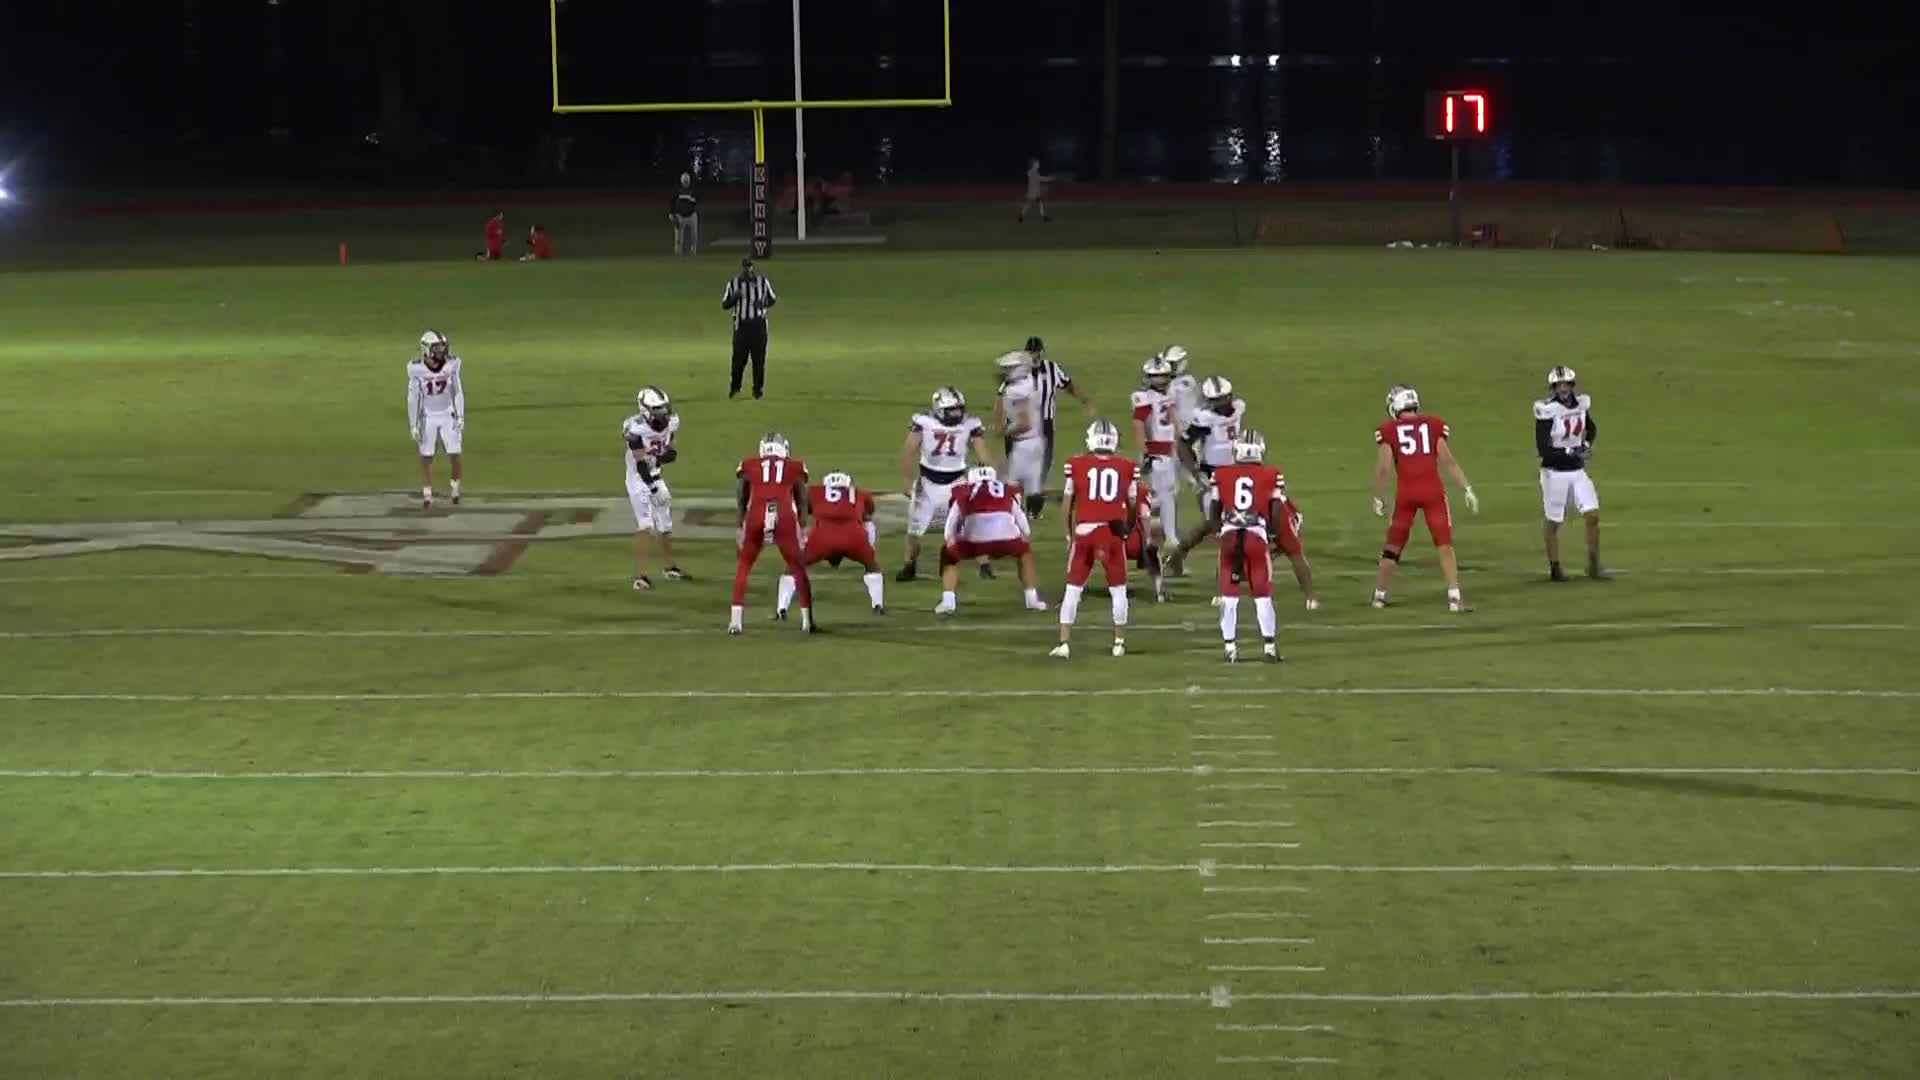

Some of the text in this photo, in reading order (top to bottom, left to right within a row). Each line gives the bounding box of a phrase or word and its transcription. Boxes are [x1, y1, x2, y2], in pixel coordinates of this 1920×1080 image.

[1446, 95, 1484, 132] 17
[754, 166, 766, 256] KENNY
[426, 380, 447, 395] 17
[931, 431, 956, 456] 71
[1396, 422, 1431, 455] 51
[761, 460, 784, 484] 11
[1087, 466, 1119, 502] 10
[825, 484, 856, 505] 61
[1234, 476, 1255, 511] 6
